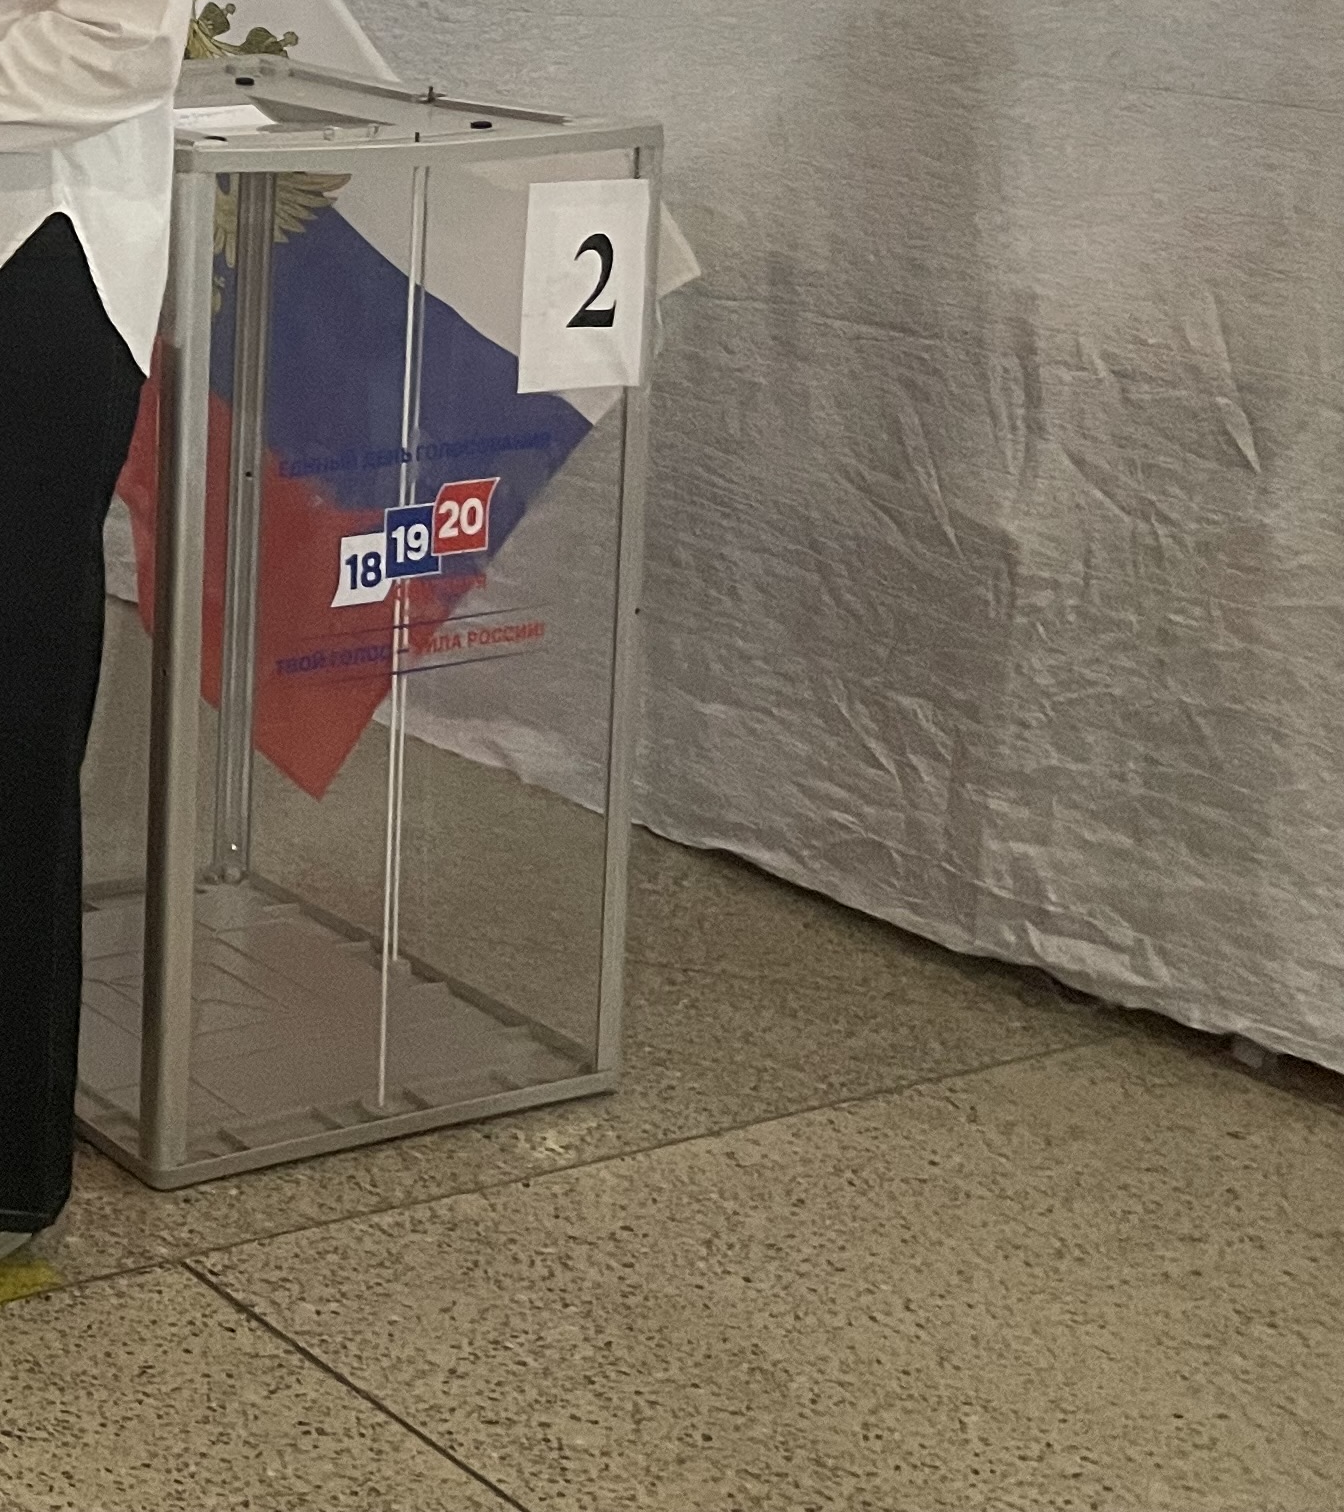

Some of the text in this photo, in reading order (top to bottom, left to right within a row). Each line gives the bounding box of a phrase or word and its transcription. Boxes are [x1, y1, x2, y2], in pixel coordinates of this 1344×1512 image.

[565, 233, 617, 329] 2
[345, 551, 382, 590] 18
[391, 523, 429, 563] 19
[438, 497, 483, 538] 20
